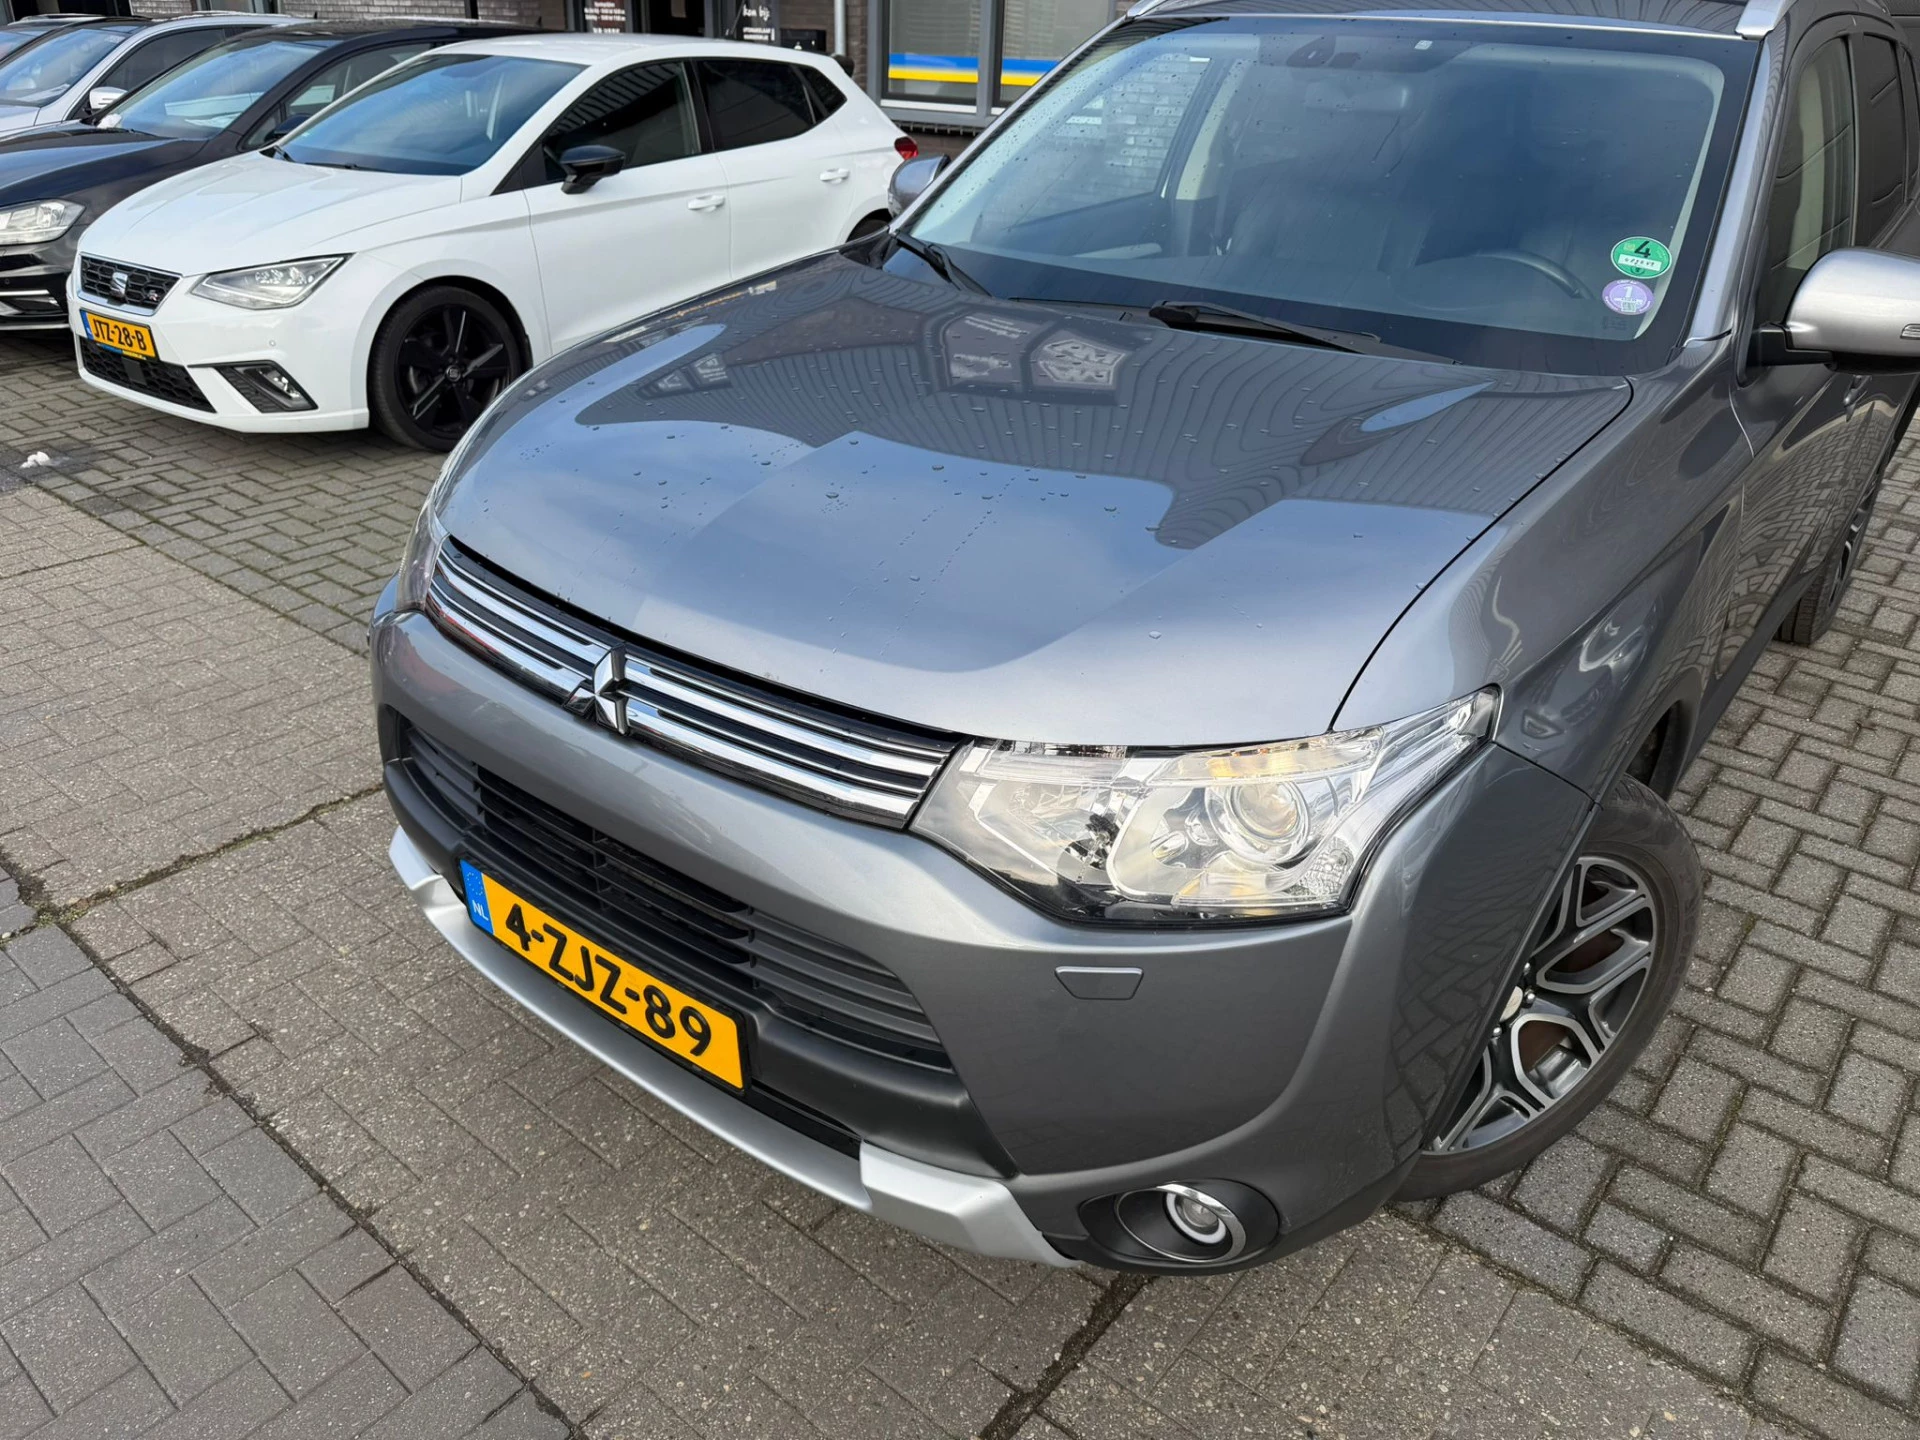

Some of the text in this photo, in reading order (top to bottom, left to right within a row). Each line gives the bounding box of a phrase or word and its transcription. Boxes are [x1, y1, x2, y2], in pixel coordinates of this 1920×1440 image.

[1635, 241, 1650, 258] 4
[93, 318, 147, 351] JTZ-28-B
[472, 899, 489, 921] NL
[505, 903, 712, 1057] 4-ZJZ-89
